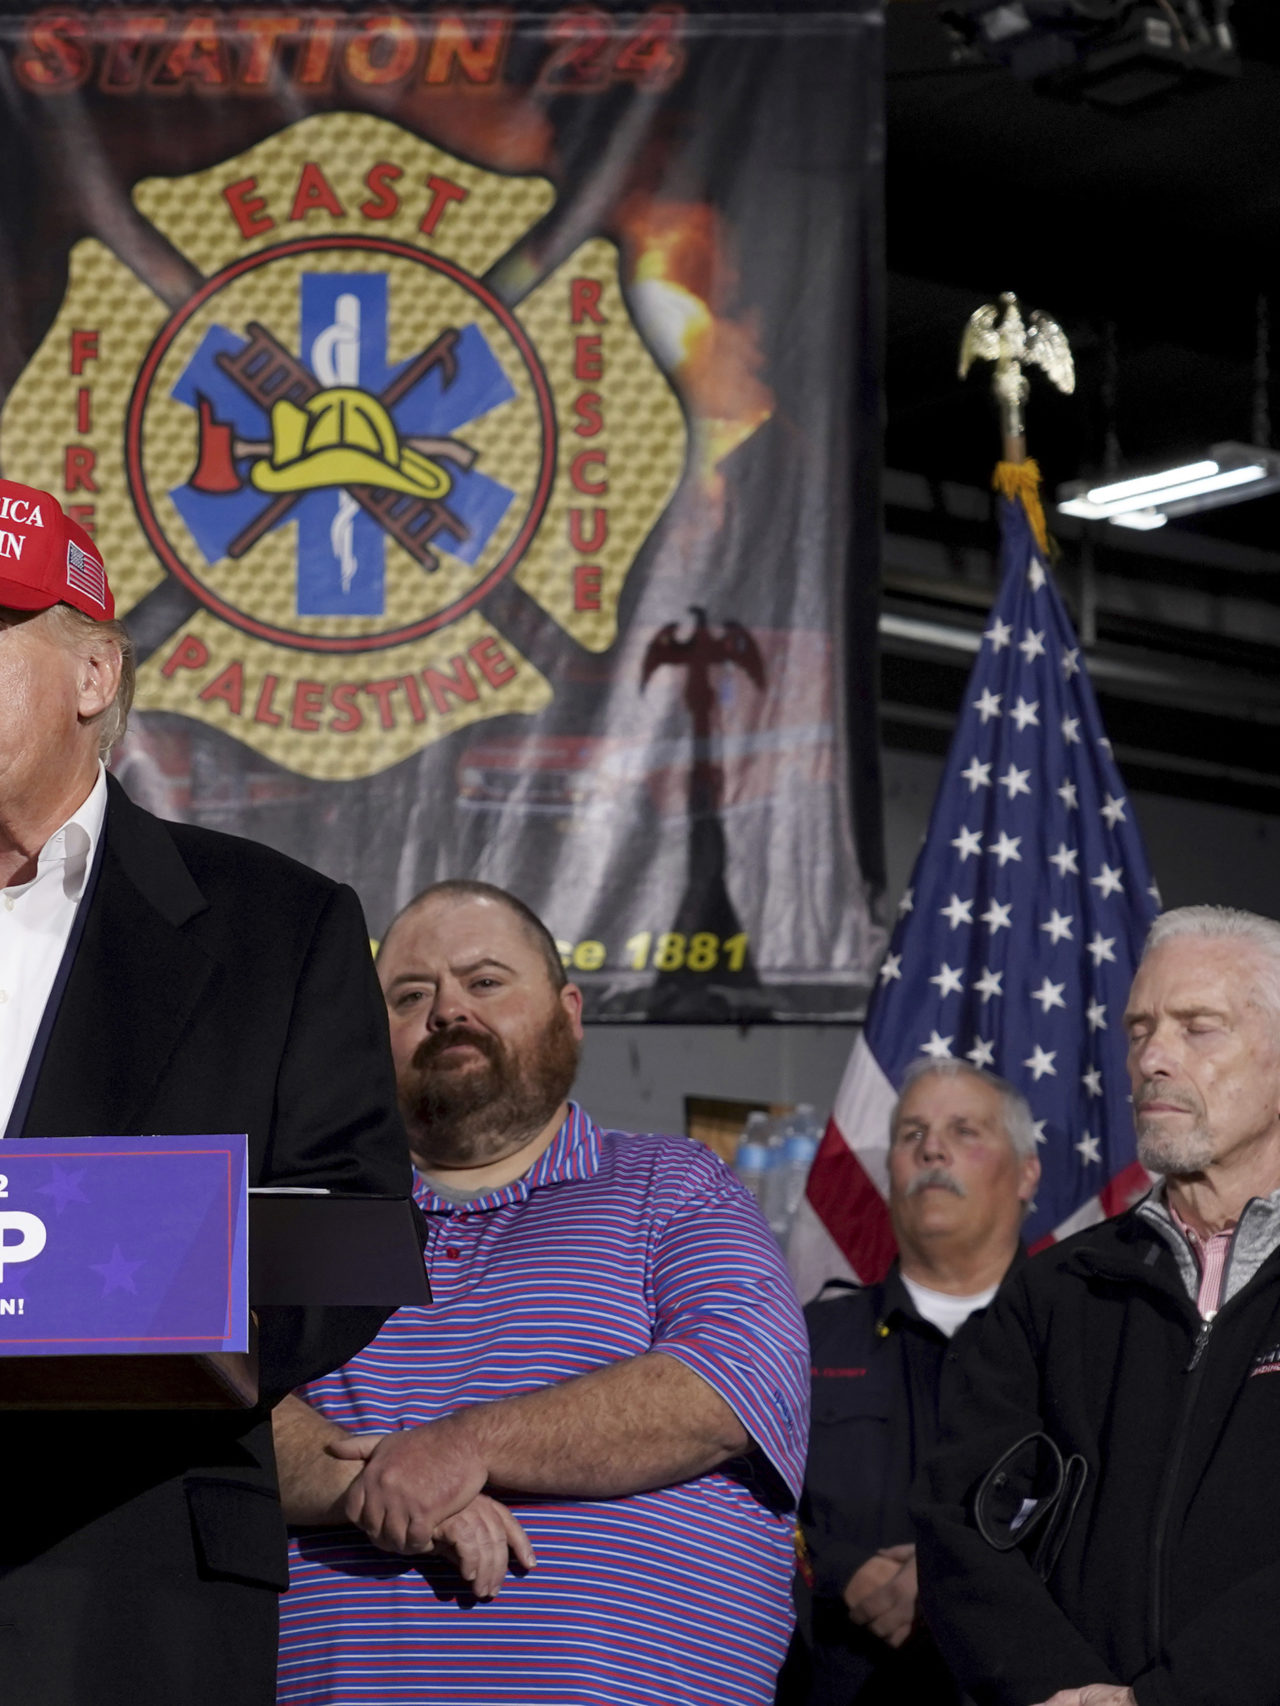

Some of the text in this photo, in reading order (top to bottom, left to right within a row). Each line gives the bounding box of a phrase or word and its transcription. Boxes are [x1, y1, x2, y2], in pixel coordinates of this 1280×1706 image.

[18, 10, 683, 90] STATION 24
[222, 162, 469, 240] EAST
[569, 278, 609, 612] RESCUE
[160, 633, 519, 733] PALESTINE
[625, 931, 751, 973] 1881
